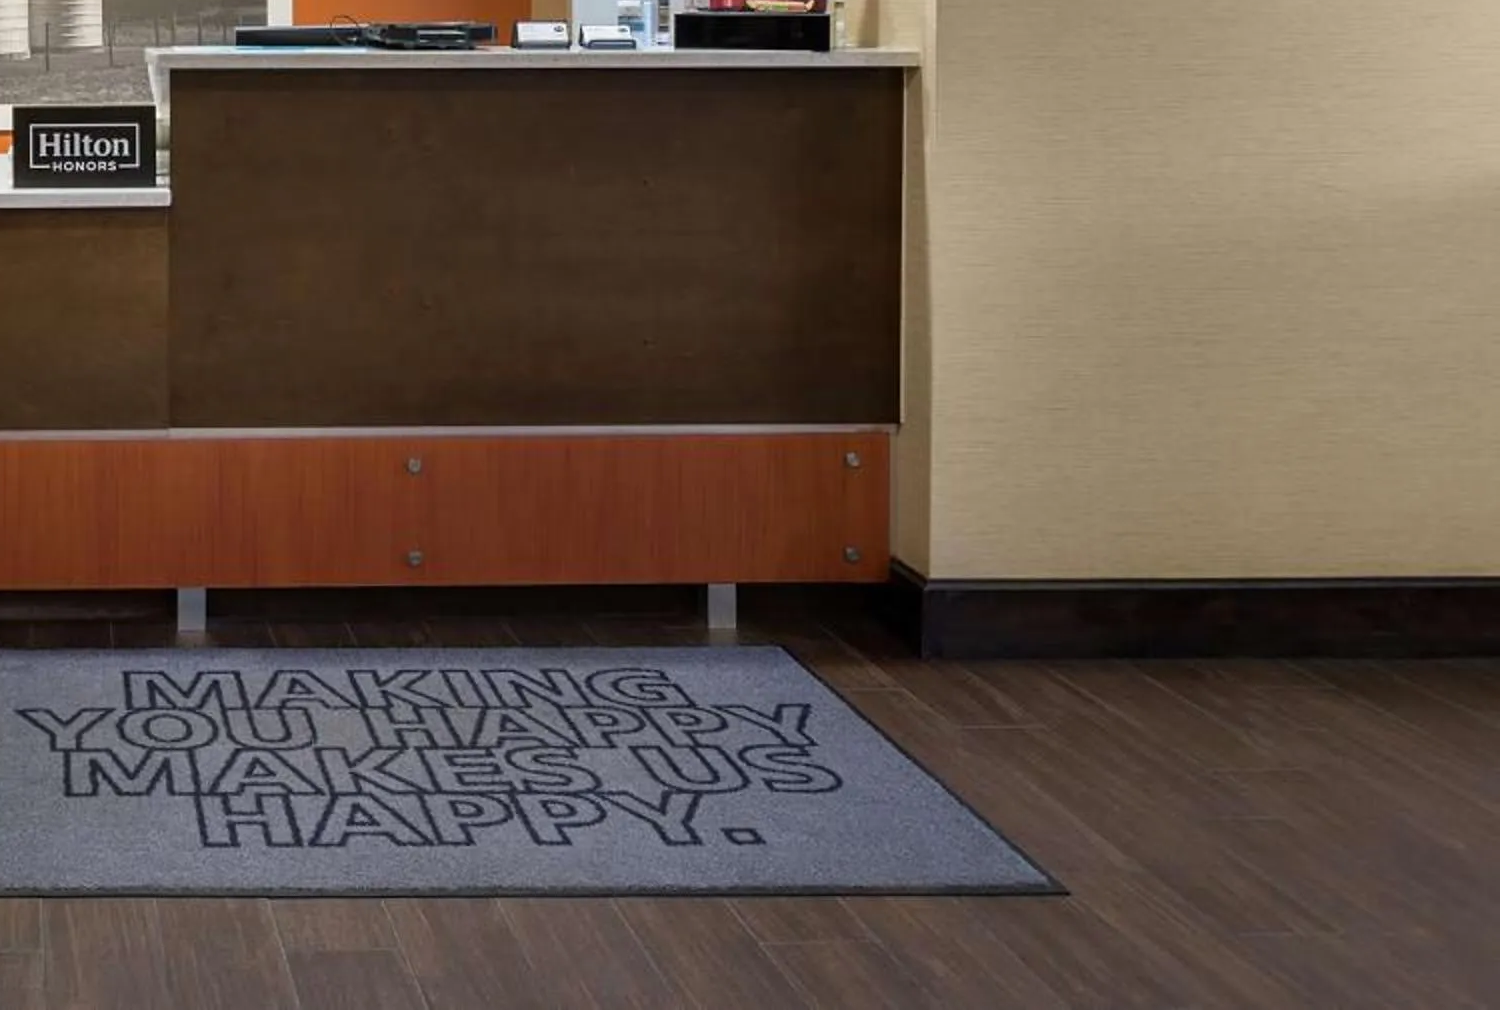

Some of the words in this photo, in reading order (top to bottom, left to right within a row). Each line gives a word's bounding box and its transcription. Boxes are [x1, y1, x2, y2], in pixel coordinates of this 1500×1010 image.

[38, 132, 131, 158] Hilton
[52, 161, 118, 172] HONORS
[122, 668, 698, 710] MAKING
[14, 706, 318, 752] YOU
[359, 702, 818, 750] HAPPY
[63, 746, 604, 797] MAKES
[627, 744, 845, 794] US
[194, 790, 767, 848] HAPPY.
